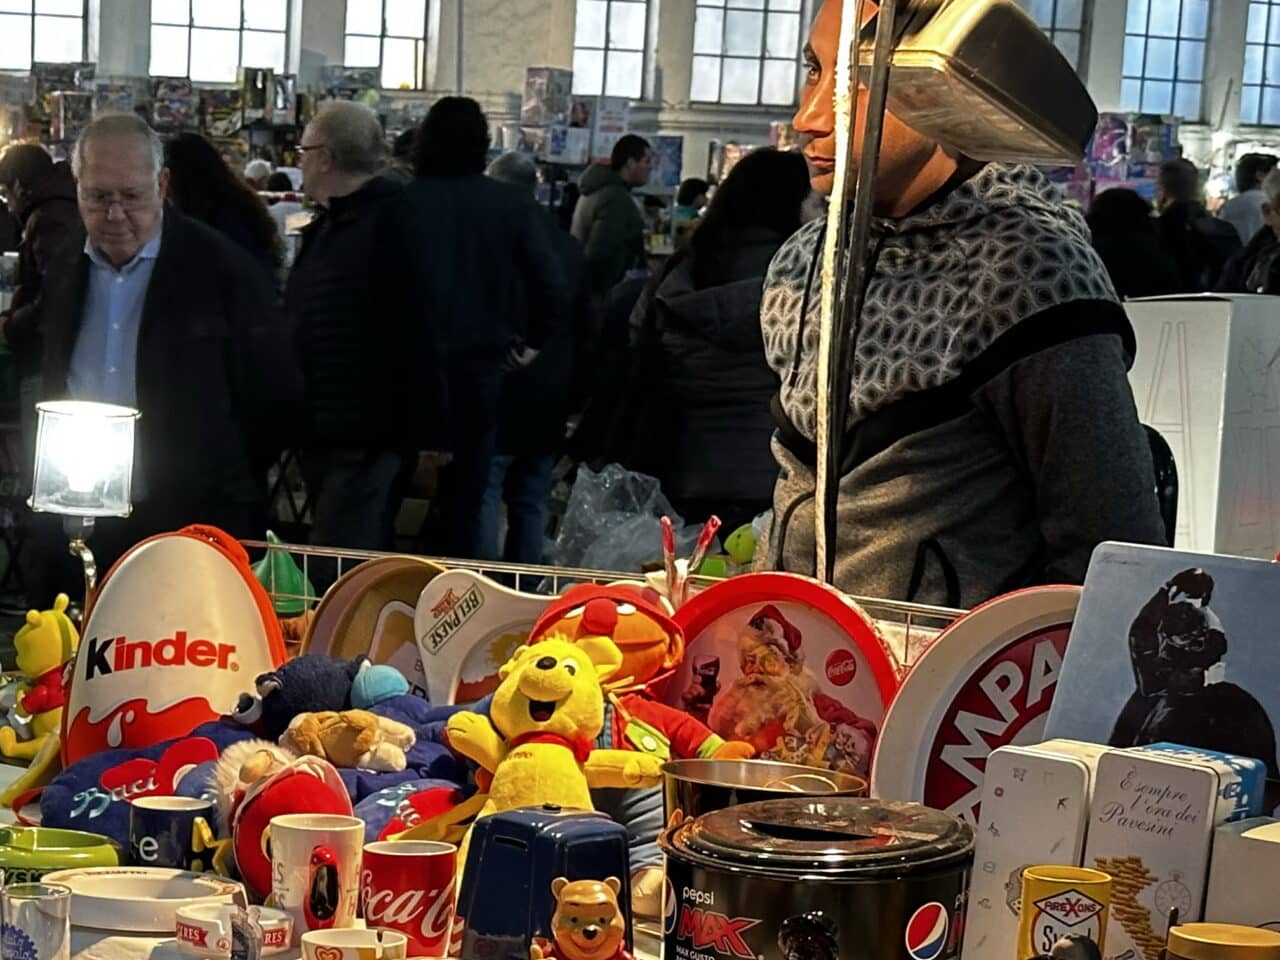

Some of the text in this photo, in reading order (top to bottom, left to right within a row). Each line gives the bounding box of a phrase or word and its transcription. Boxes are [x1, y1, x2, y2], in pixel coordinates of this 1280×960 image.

[85, 630, 237, 681] Kinder
[70, 769, 160, 819] Baci
[1135, 784, 1188, 805] sempre
[1099, 801, 1177, 836] Pavesini
[1175, 804, 1200, 823] dei
[682, 886, 715, 905] pepsi
[677, 903, 763, 960] MAX
